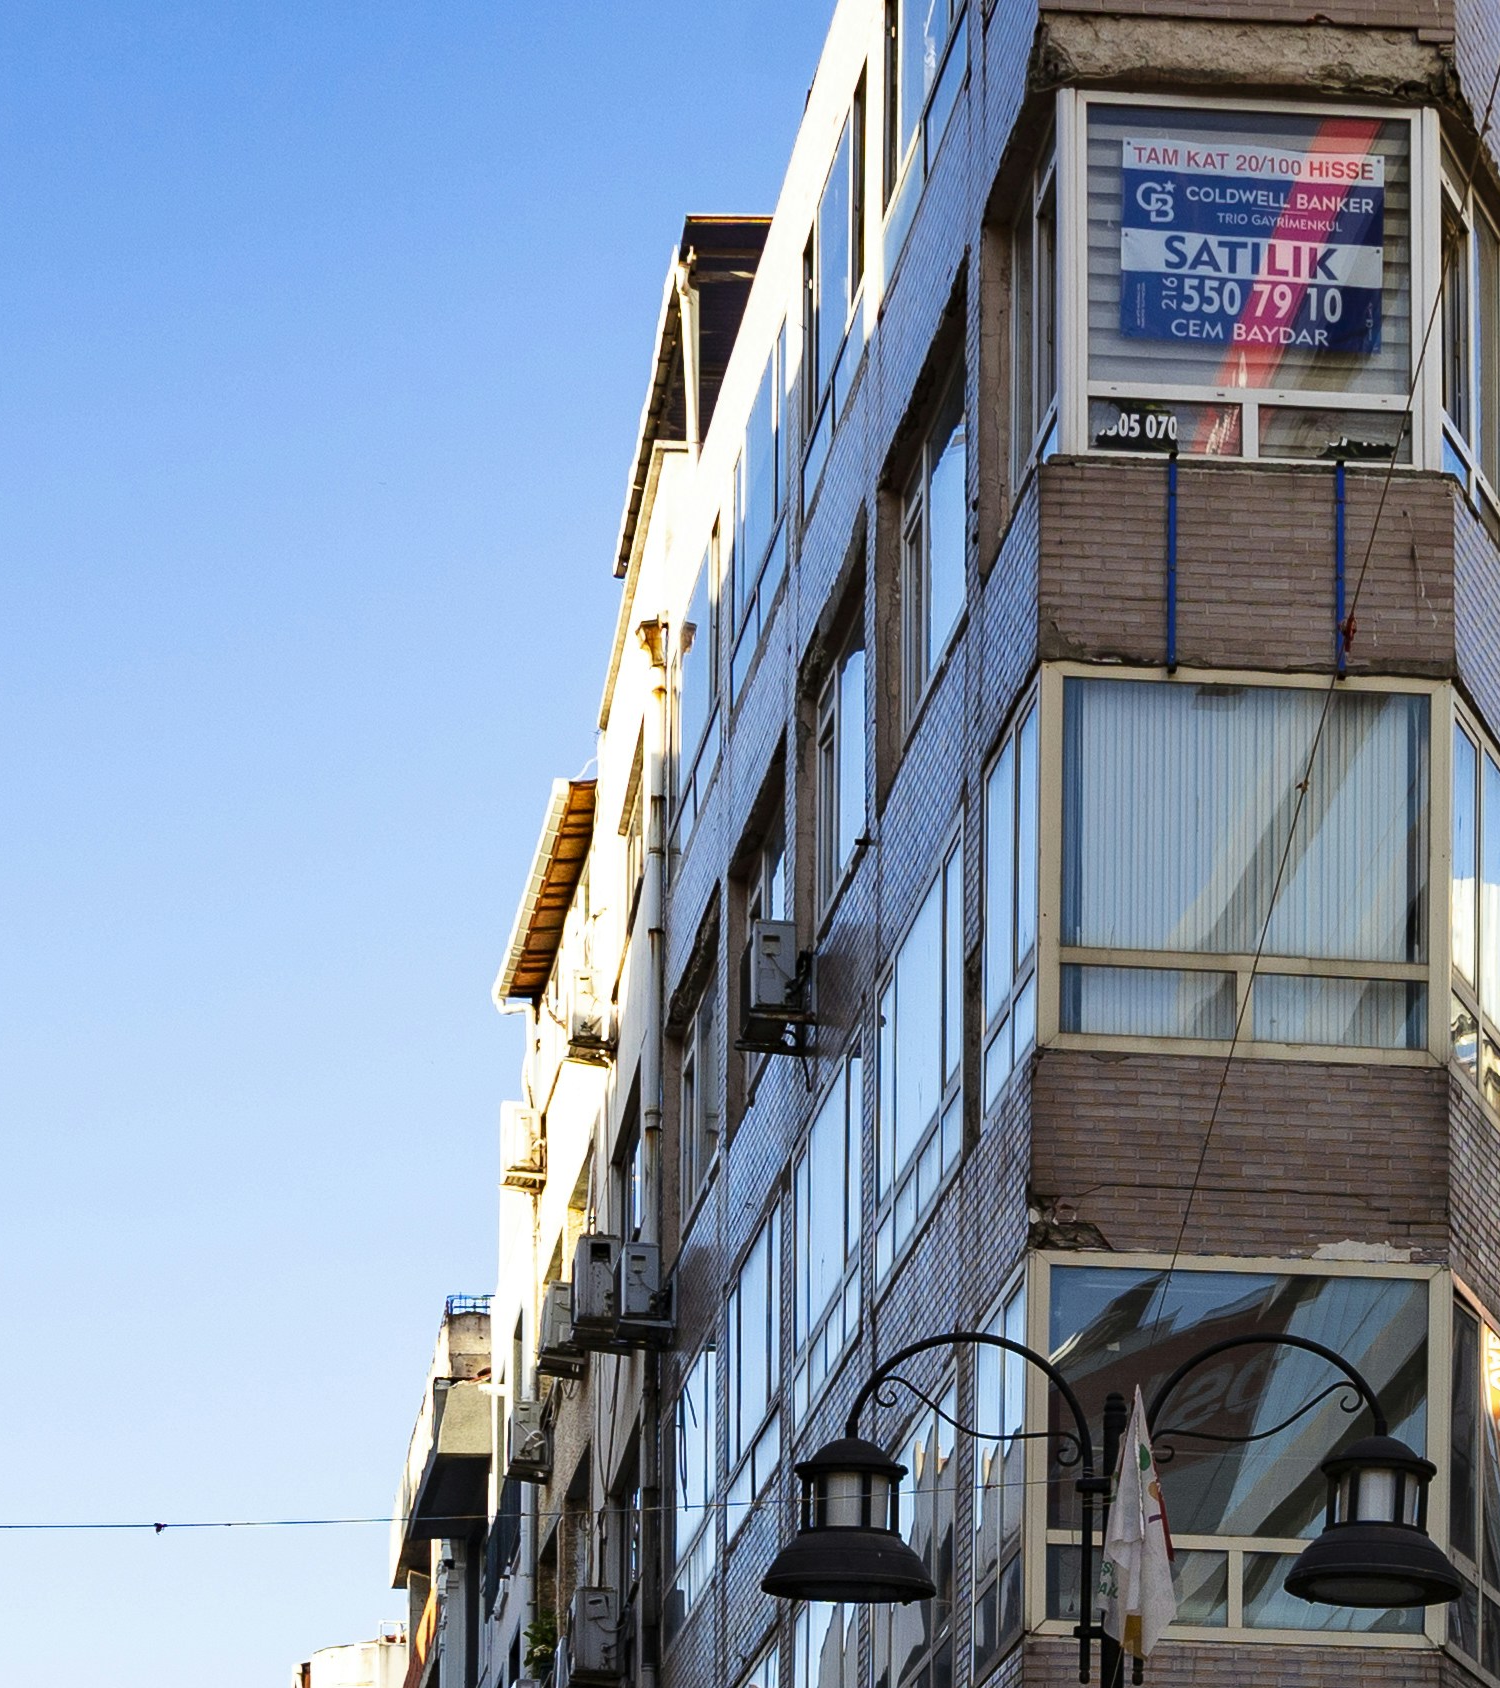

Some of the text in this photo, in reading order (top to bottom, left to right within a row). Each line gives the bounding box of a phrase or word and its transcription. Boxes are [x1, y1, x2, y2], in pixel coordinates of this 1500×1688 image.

[1134, 147, 1178, 166] TAM
[1186, 150, 1229, 170] KAT
[1236, 155, 1301, 176] 20/100
[1186, 187, 1374, 214] COLDWELL BANKER
[1217, 212, 1342, 232] TRIO GAYRİMENKUL
[1164, 235, 1338, 281] SATILIK
[1162, 277, 1177, 310] 216
[1181, 279, 1241, 315] 550
[1253, 283, 1292, 318] 79
[1307, 287, 1342, 323] 10
[1171, 319, 1329, 346] CEM BAYDAR
[1145, 415, 1178, 440] 070
